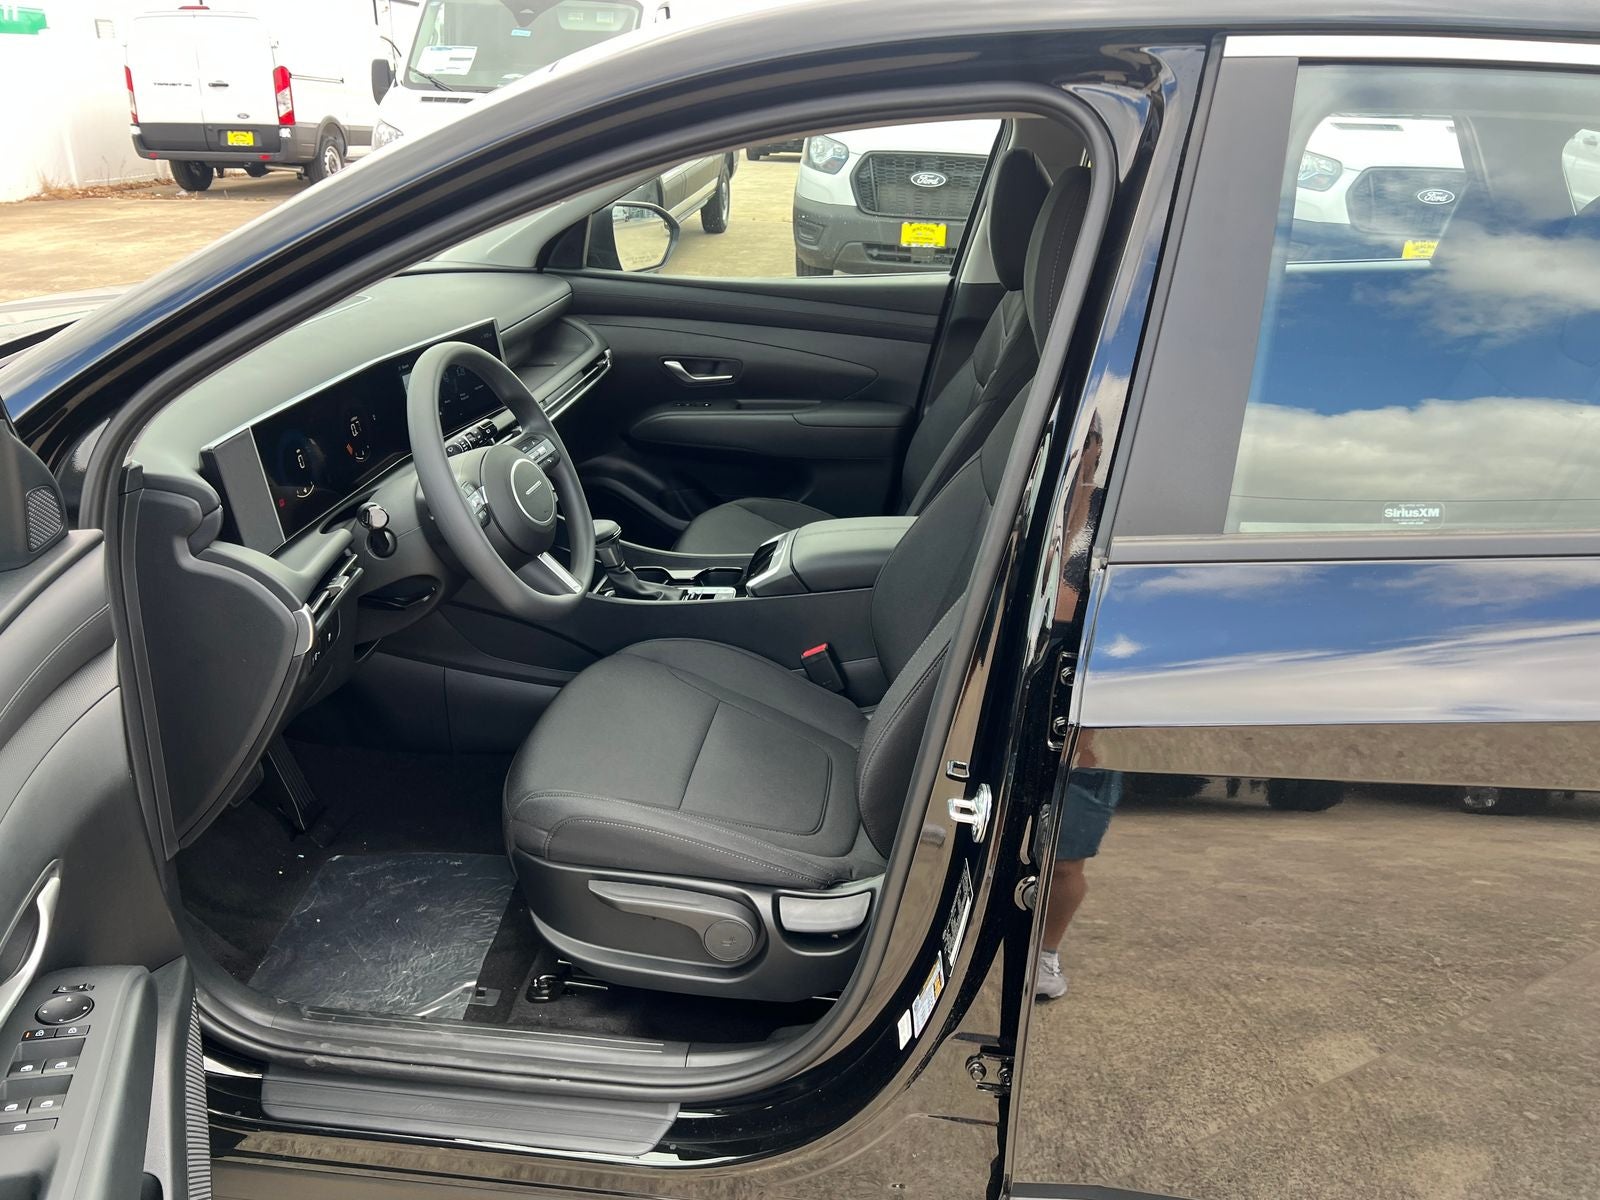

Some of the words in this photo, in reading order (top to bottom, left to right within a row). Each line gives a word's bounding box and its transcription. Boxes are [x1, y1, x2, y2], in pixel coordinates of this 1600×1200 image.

[915, 173, 942, 185] Ford
[1422, 190, 1450, 203] Ford
[1384, 508, 1440, 518] SiriusXM
